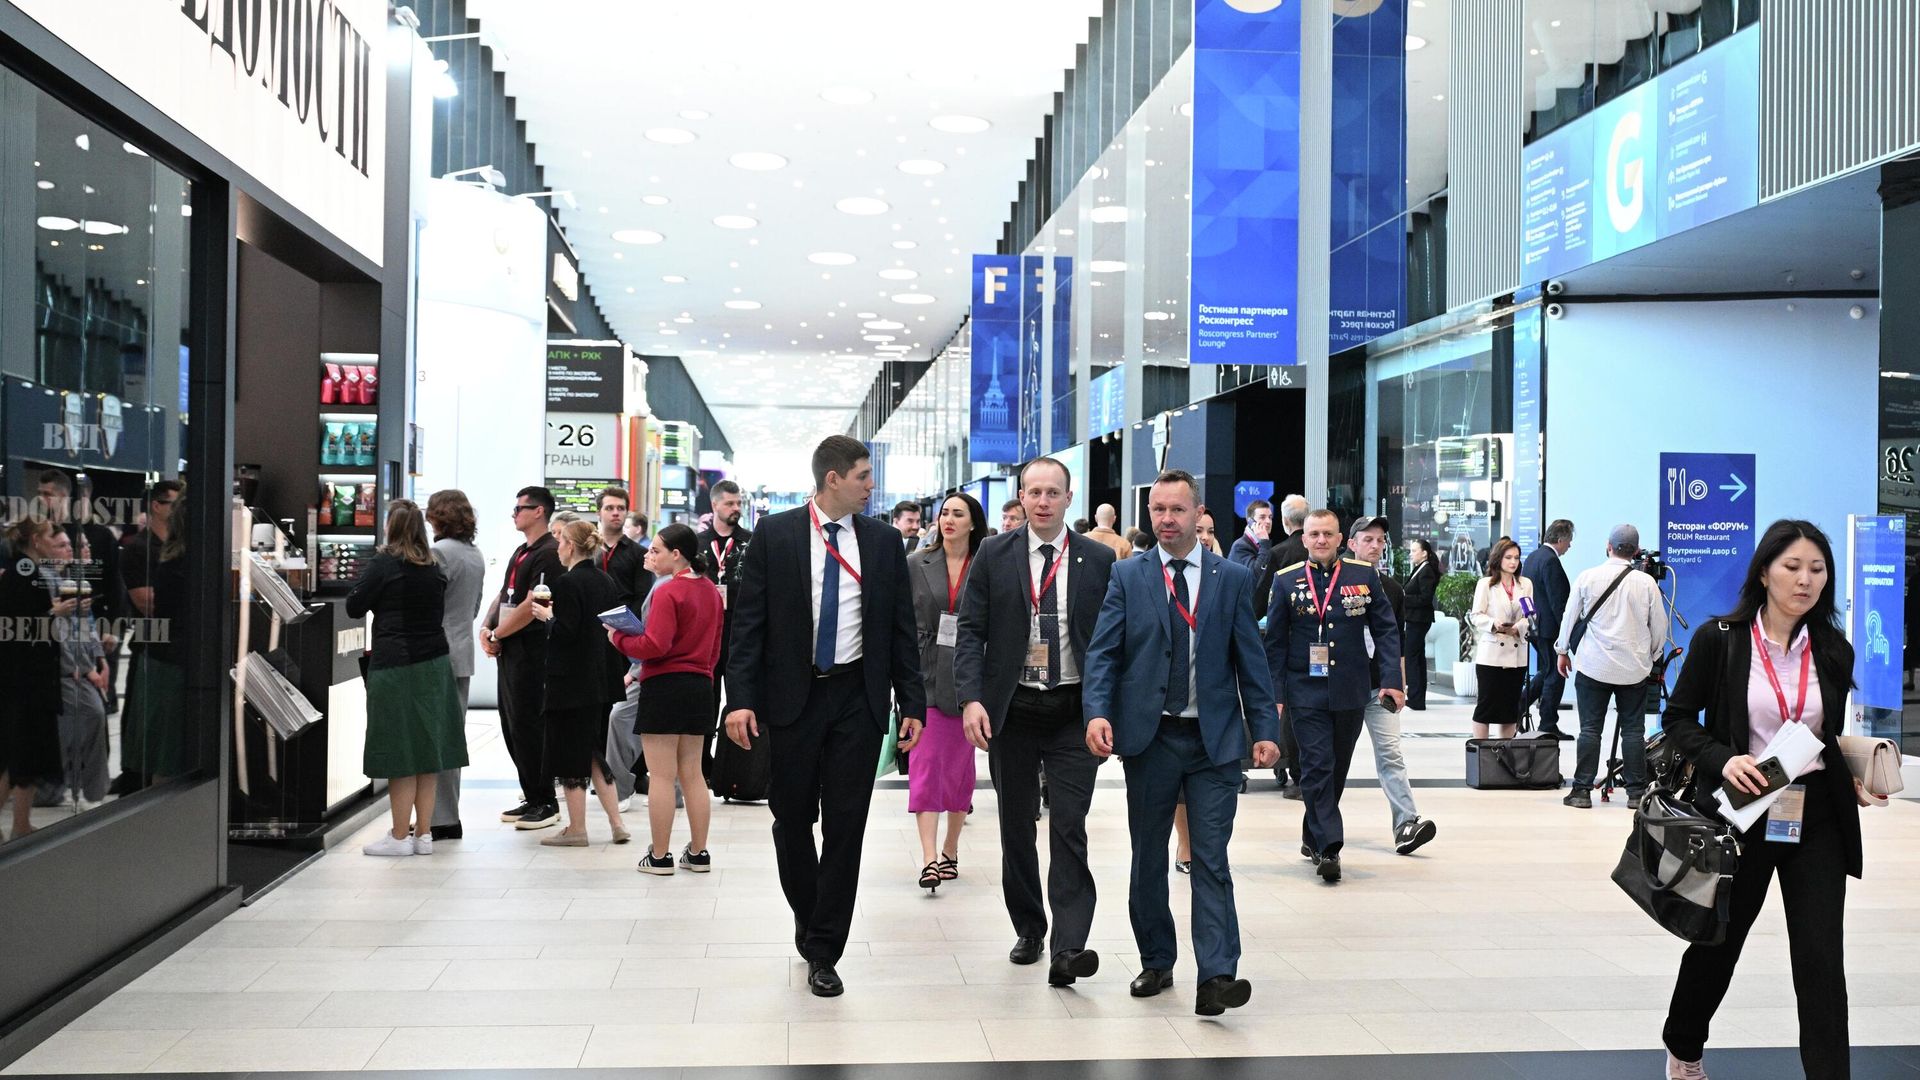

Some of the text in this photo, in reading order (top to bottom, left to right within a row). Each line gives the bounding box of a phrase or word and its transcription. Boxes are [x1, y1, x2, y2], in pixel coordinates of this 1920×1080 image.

[181, 0, 370, 179] МОСТИ
[1606, 111, 1644, 233] G
[984, 266, 1008, 305] F
[1199, 304, 1288, 317] Гостиная партнеров
[1199, 315, 1254, 327] Росконгресс
[1198, 329, 1244, 339] Roscongress
[1198, 339, 1226, 349] Lounge
[548, 351, 571, 360] АПК
[581, 351, 602, 360] РХК
[1667, 521, 1749, 532] Ресторан «ФОРУМ»
[1667, 533, 1730, 541] FORUM Restaurant
[1667, 547, 1737, 556] Внутренний двор G
[1667, 556, 1696, 564] Courtyard
[1862, 564, 1895, 574] ИНФОРМАЦИЯ
[1864, 577, 1894, 586] INFORMATION
